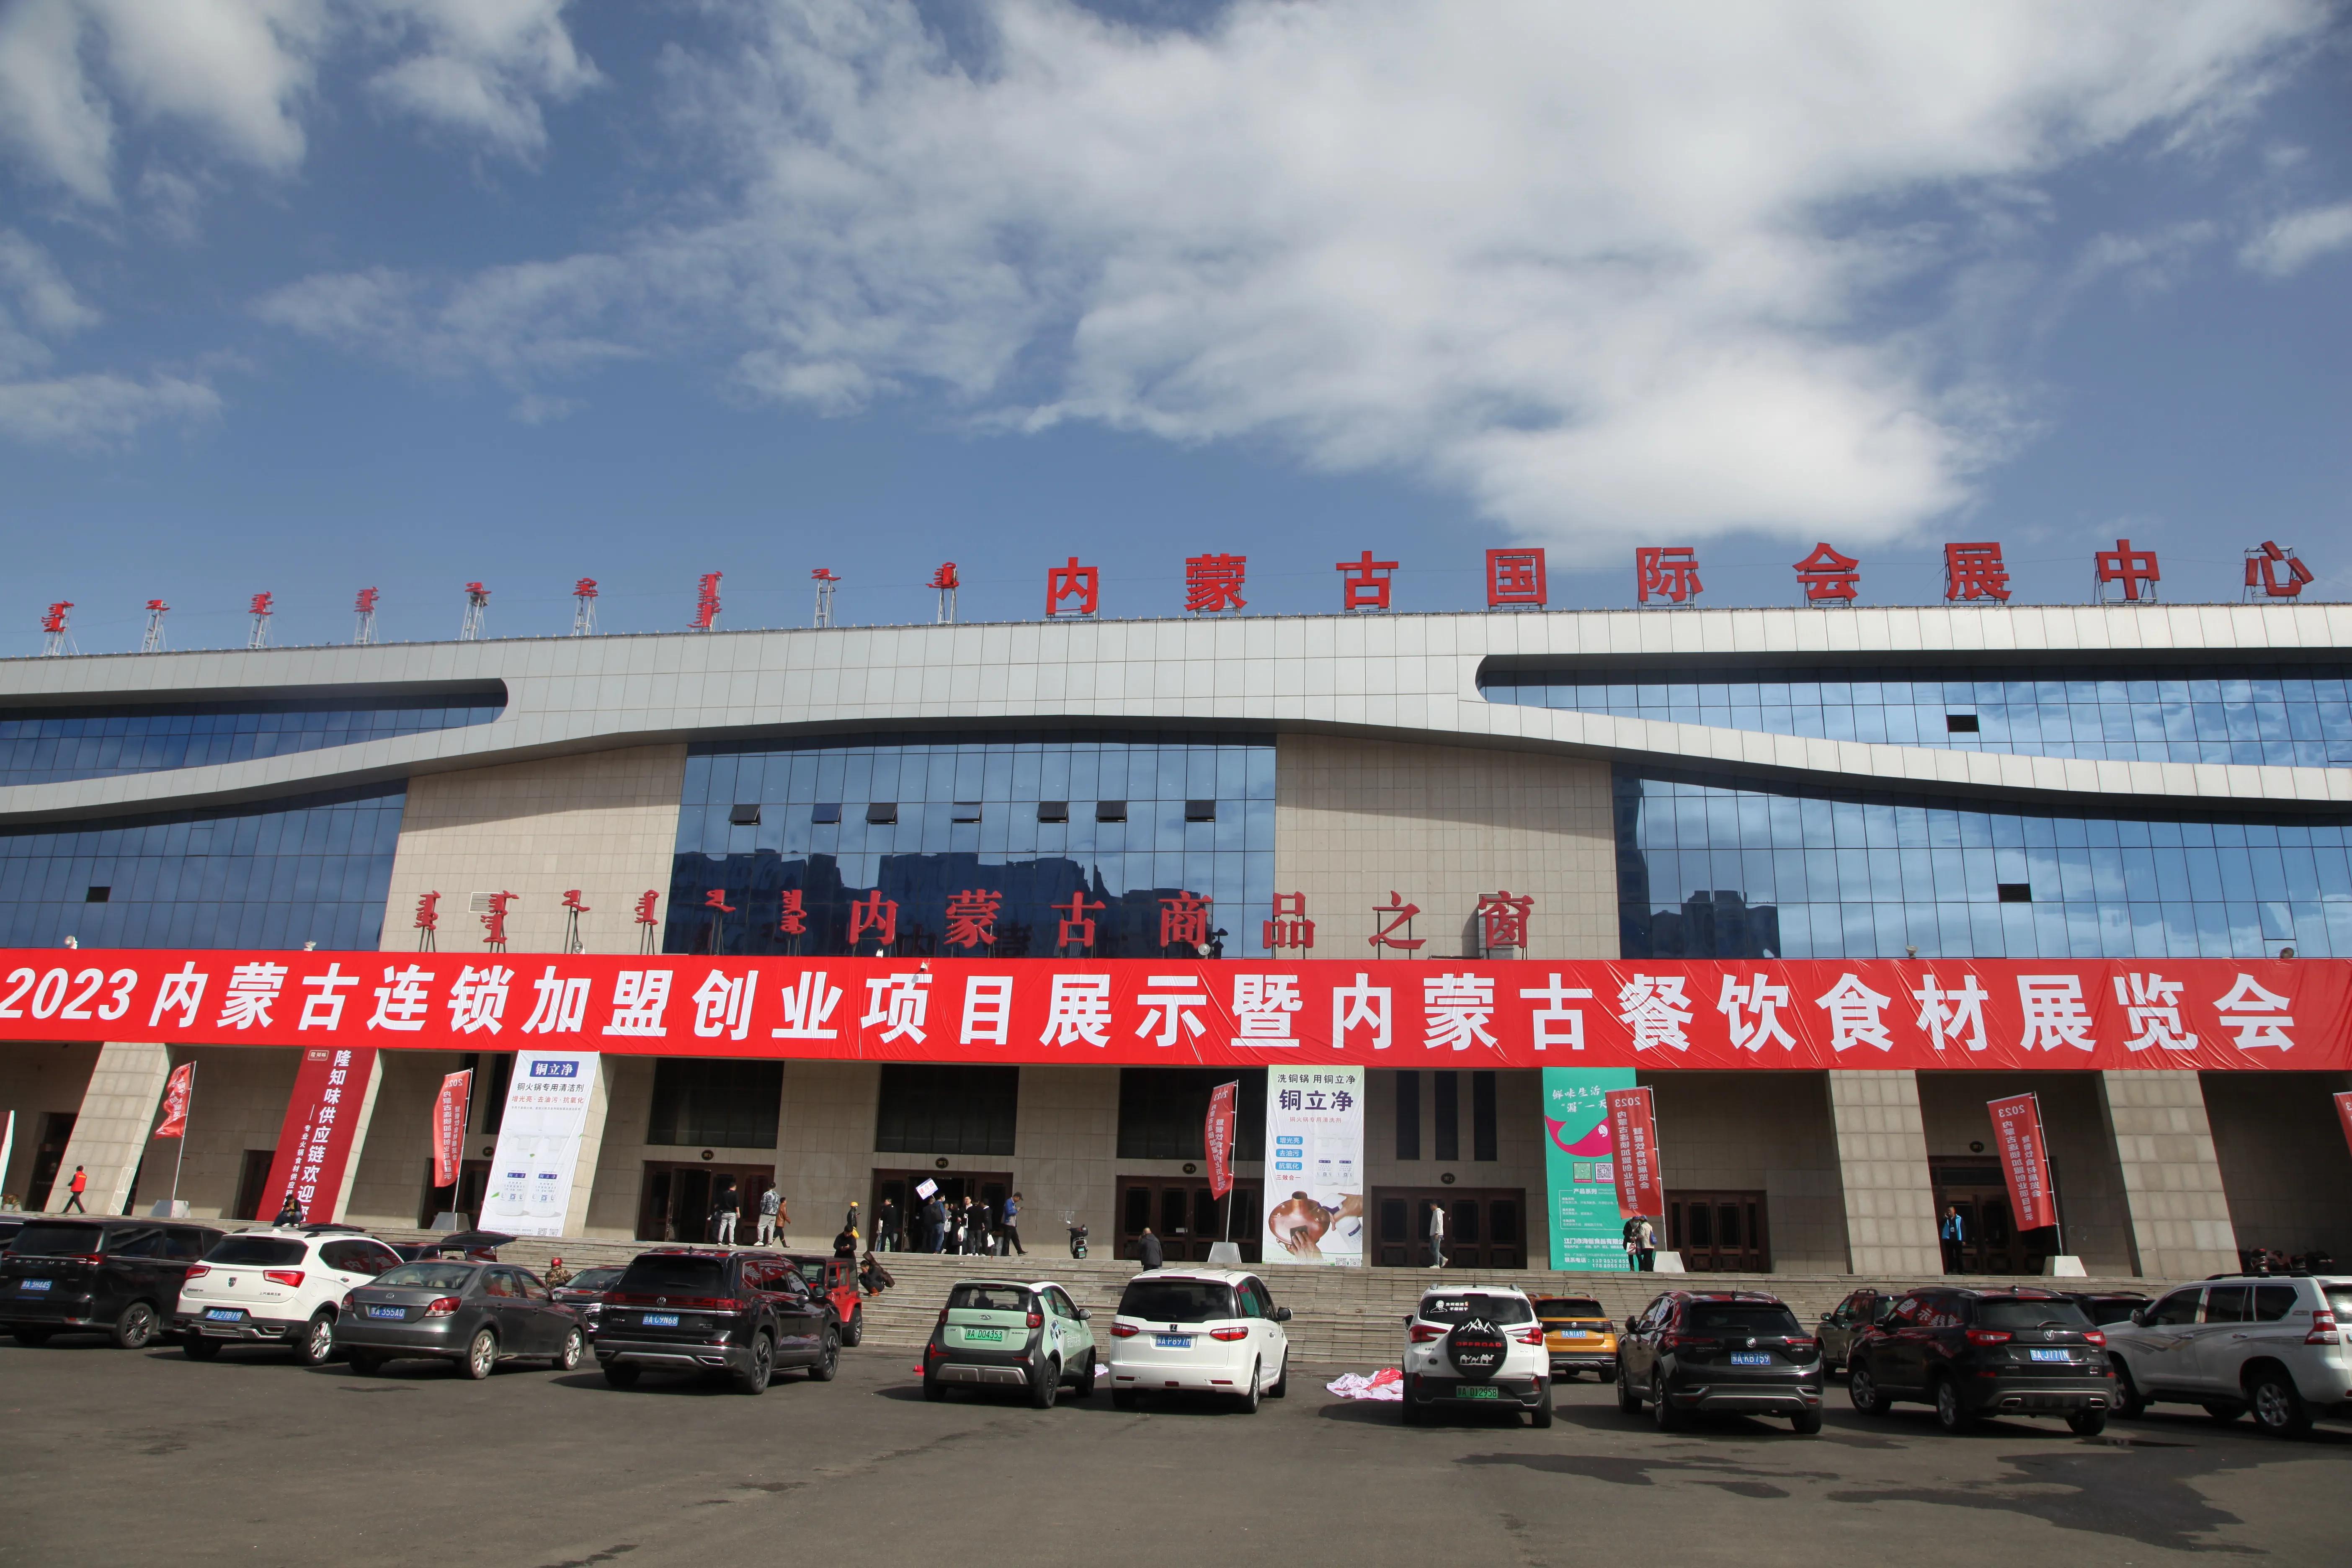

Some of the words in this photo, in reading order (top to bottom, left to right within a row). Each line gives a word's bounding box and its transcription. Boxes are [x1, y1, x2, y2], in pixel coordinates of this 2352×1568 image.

[1047, 540, 2313, 614] 内蒙古国际会展中心
[849, 889, 1534, 949] 内蒙古商品之窗
[535, 1063, 573, 1076] 铜立净
[517, 1083, 584, 1092] 铜火锅专用清洁剂
[1552, 1085, 1601, 1100] 鲜味生活
[1279, 1089, 1354, 1112] 铜立净
